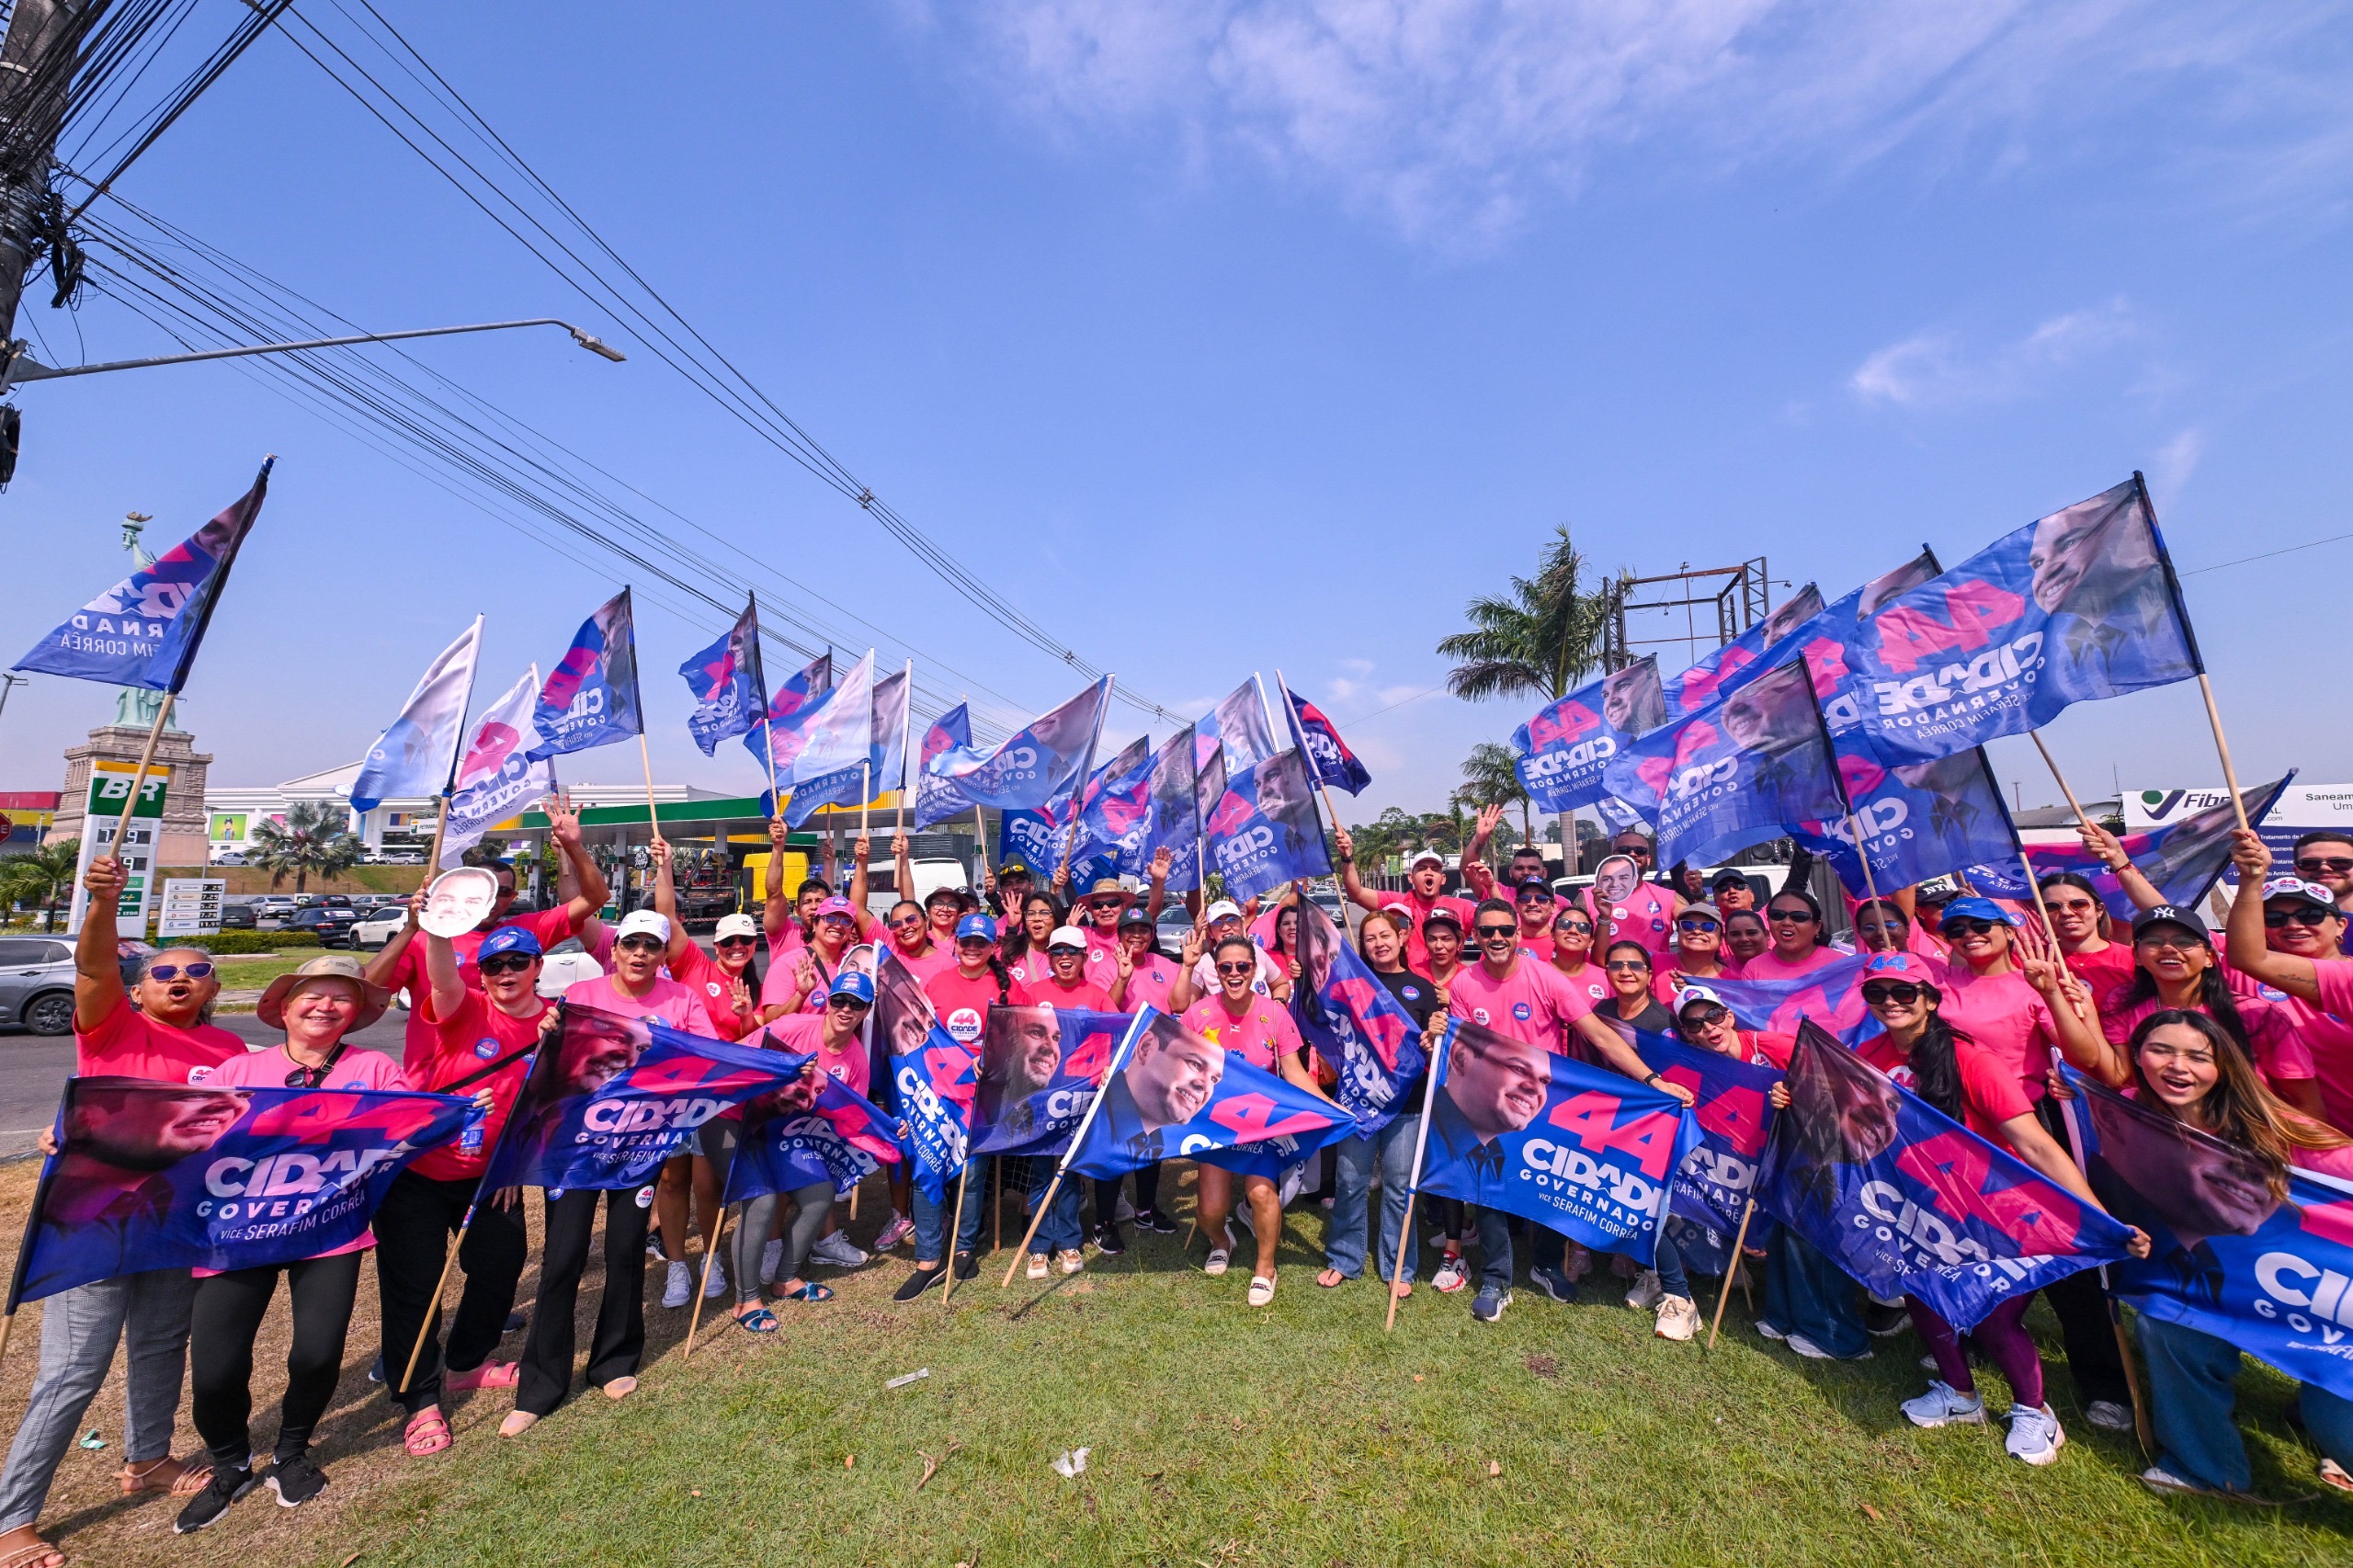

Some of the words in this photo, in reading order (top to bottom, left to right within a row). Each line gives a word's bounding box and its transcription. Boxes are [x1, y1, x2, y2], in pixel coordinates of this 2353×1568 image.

[98, 778, 160, 801] BR
[100, 829, 139, 844] 7.9
[2154, 906, 2176, 918] NY
[1870, 955, 1906, 971] 44
[953, 1013, 976, 1026] 44
[1064, 1032, 1112, 1086] 4
[1342, 1065, 1379, 1119] NADOR
[248, 1093, 446, 1144] 44
[574, 1131, 683, 1149] GOVERNA
[1548, 1089, 1680, 1181] 44
[593, 1151, 608, 1161] VICE
[607, 1150, 656, 1165] SERAFIM
[801, 1152, 814, 1161] VICE
[918, 1144, 942, 1176] CORRÊA
[1520, 1168, 1654, 1232] GOVERNADO
[1895, 1130, 2082, 1256] 44
[221, 1228, 244, 1240] VICE
[244, 1215, 317, 1241] SERAFIM
[322, 1189, 366, 1225] CORRÊA
[1539, 1192, 1552, 1202] VICE
[1552, 1196, 1597, 1224] SERAFIM
[1599, 1217, 1638, 1240] CORRÊA
[1875, 1248, 1893, 1264] VICE
[2254, 1299, 2345, 1345] GOV
